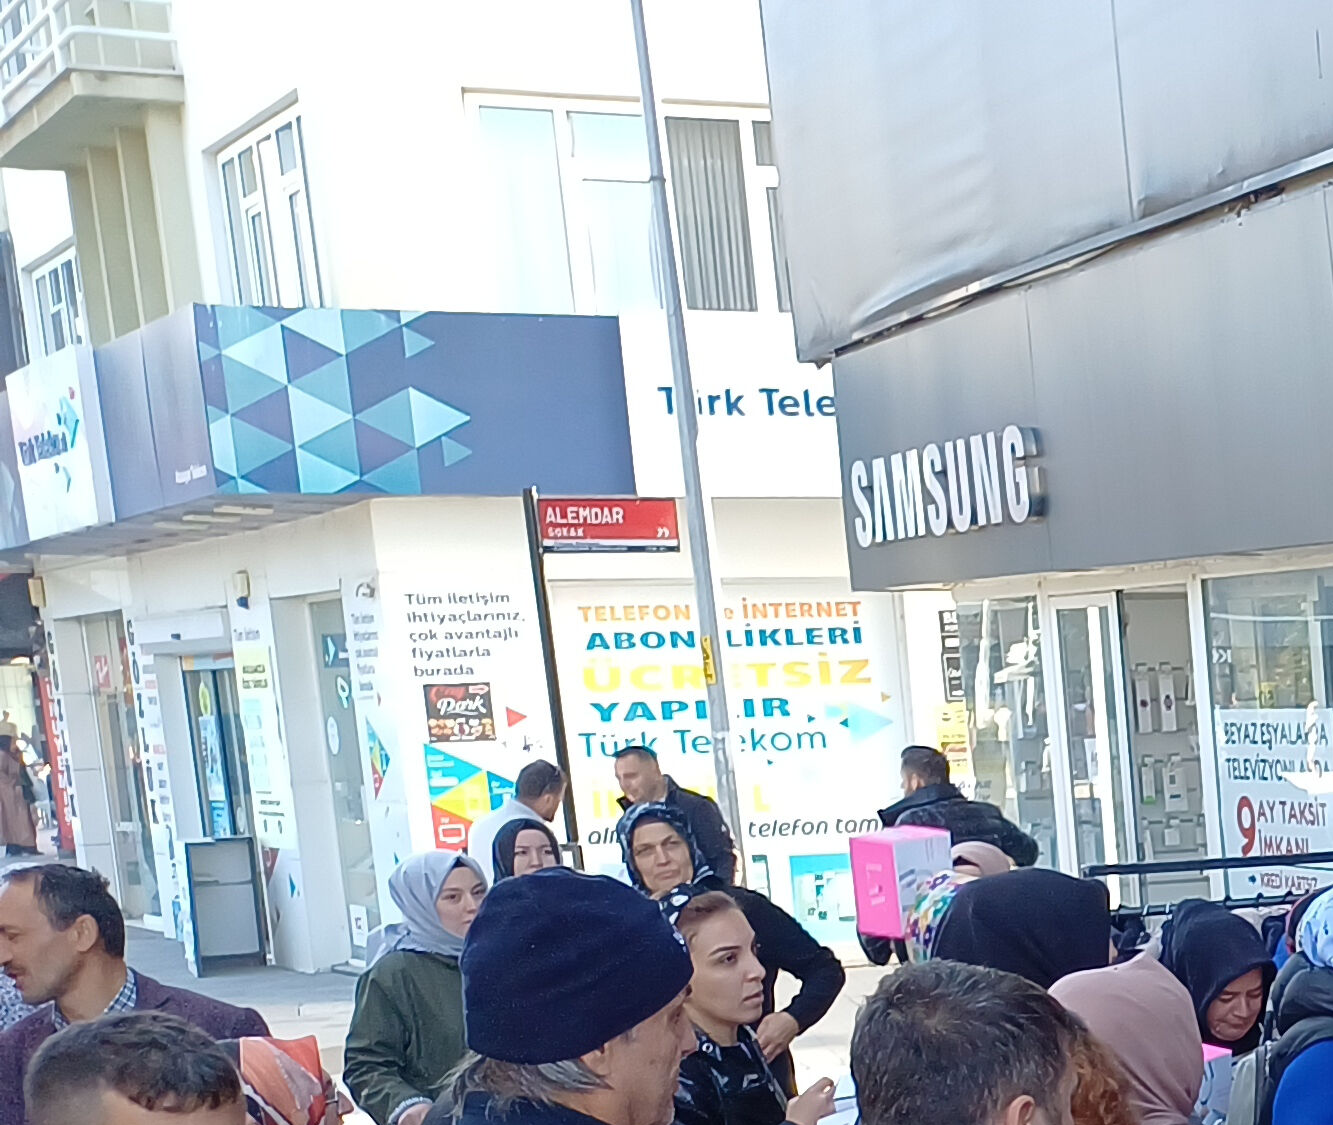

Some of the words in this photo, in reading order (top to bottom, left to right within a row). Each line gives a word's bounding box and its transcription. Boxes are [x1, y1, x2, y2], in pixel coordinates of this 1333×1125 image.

[852, 425, 1031, 547] SAMSUNG
[545, 506, 624, 524] ALEMDAR
[404, 593, 443, 605] Tüm
[577, 604, 691, 623] TELEFON
[742, 597, 861, 620] İNTERNET
[409, 629, 438, 643] çok
[444, 627, 519, 641] avantajlı
[586, 621, 863, 650] ABONLİKLERİ
[411, 646, 491, 661] fiyatlarla
[413, 664, 475, 677] burada
[590, 698, 791, 722] YAPIIR
[1225, 722, 1258, 744] BEYAZ
[748, 818, 828, 838] telefon
[835, 817, 884, 834] tam
[1237, 795, 1256, 857] 9
[1257, 800, 1276, 824] AY
[1280, 796, 1327, 827] TAKSİT
